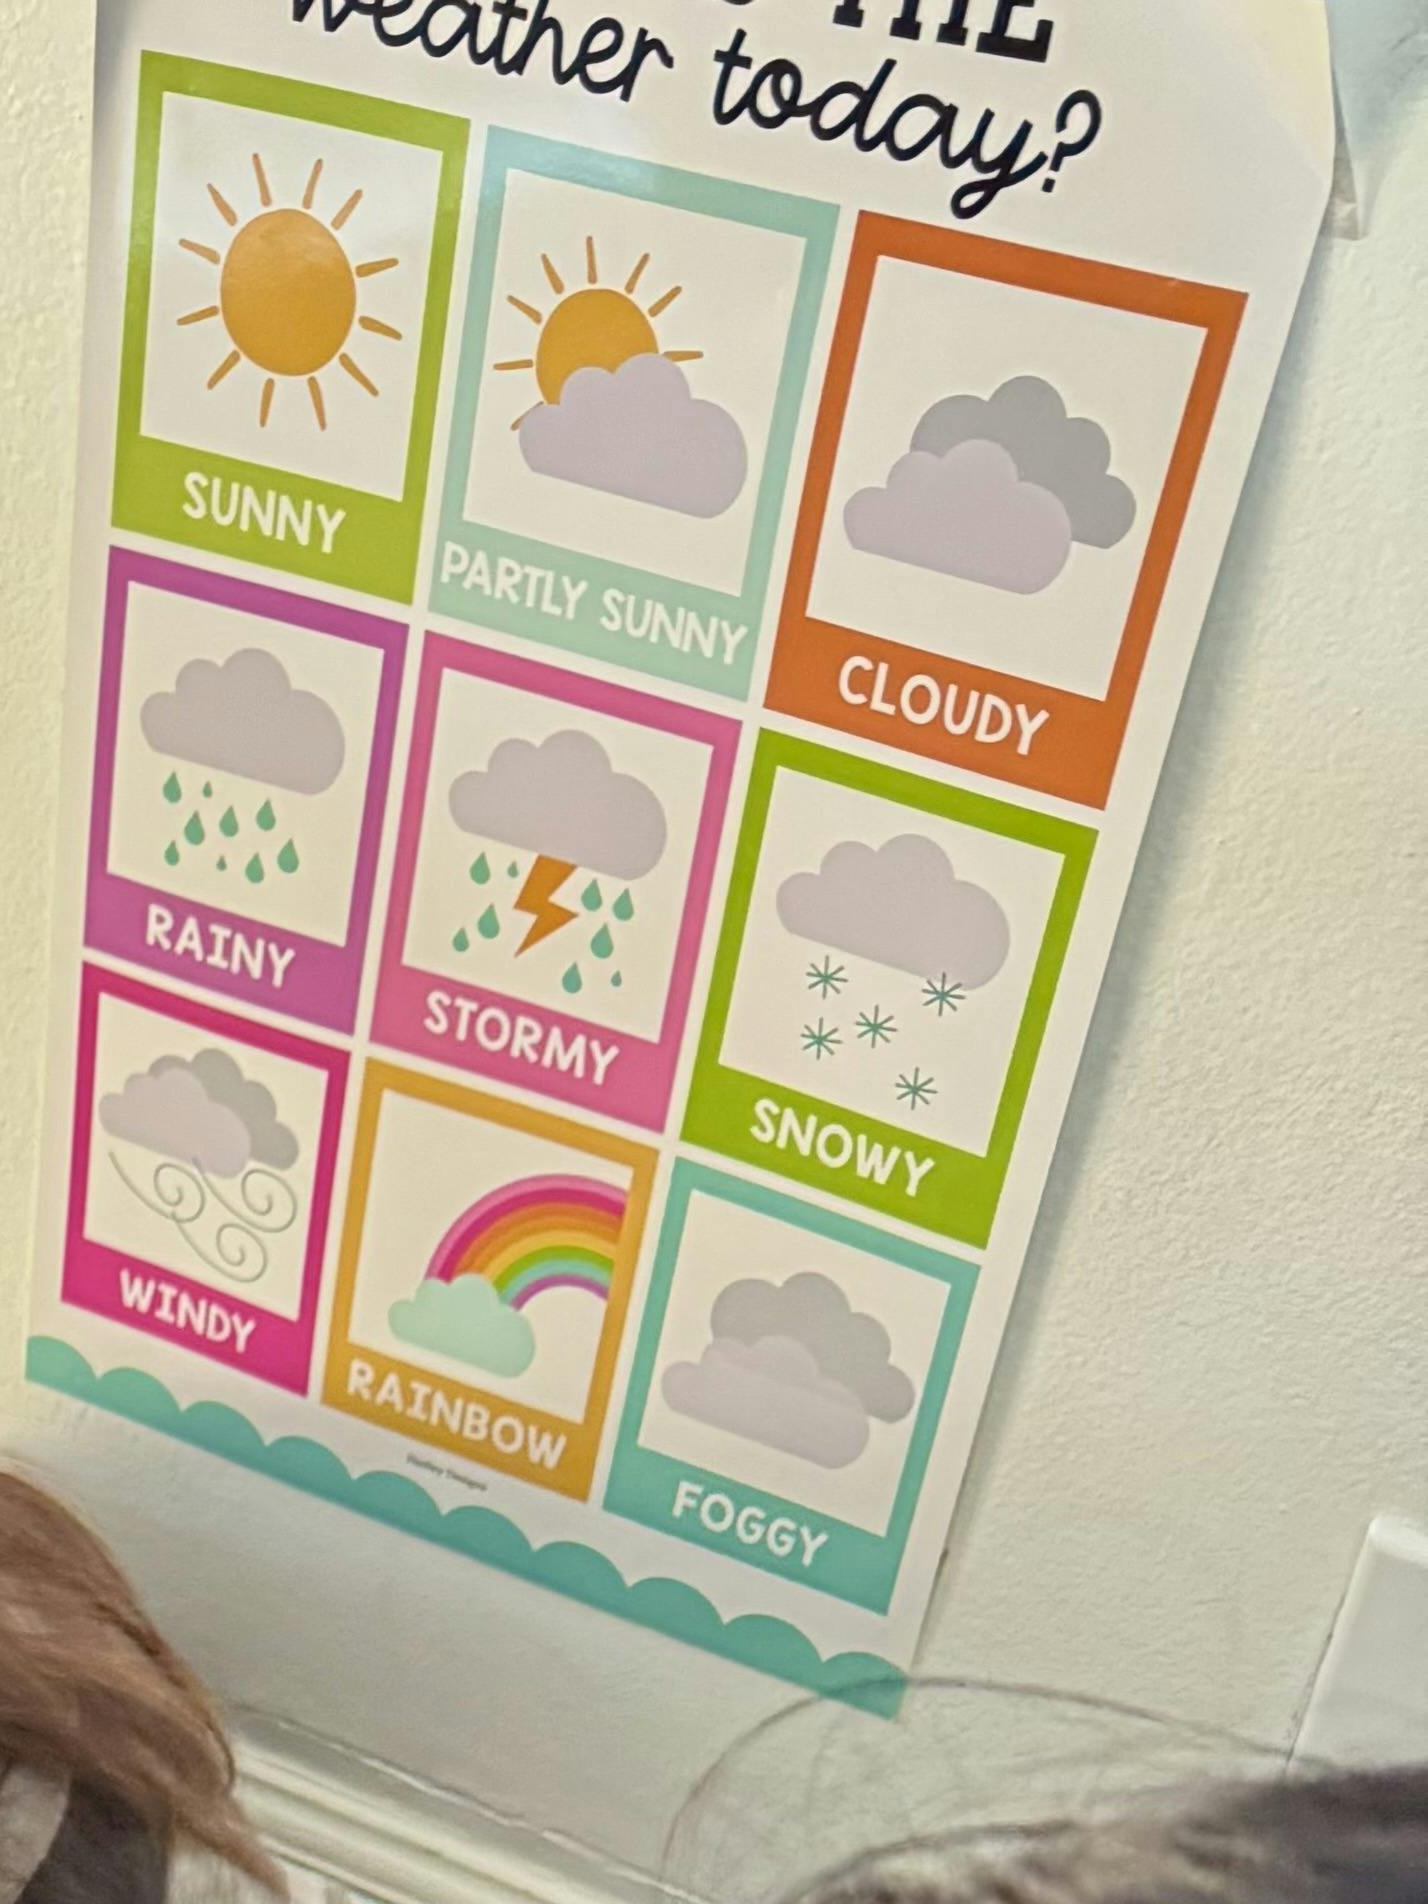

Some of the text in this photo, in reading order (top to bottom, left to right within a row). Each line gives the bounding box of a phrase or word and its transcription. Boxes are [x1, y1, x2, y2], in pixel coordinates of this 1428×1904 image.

[714, 27, 1102, 220] today?
[182, 470, 347, 554] SUNNY
[441, 541, 750, 667] PARTLY SUNNY
[838, 653, 1050, 757] CLOUDY
[146, 903, 297, 990] RAINY
[423, 990, 621, 1089] STORMY
[748, 1097, 936, 1201] SNOWY
[120, 1265, 256, 1354] WINDY
[345, 1357, 569, 1471] RAINBOW
[673, 1477, 830, 1571] FOGGY
